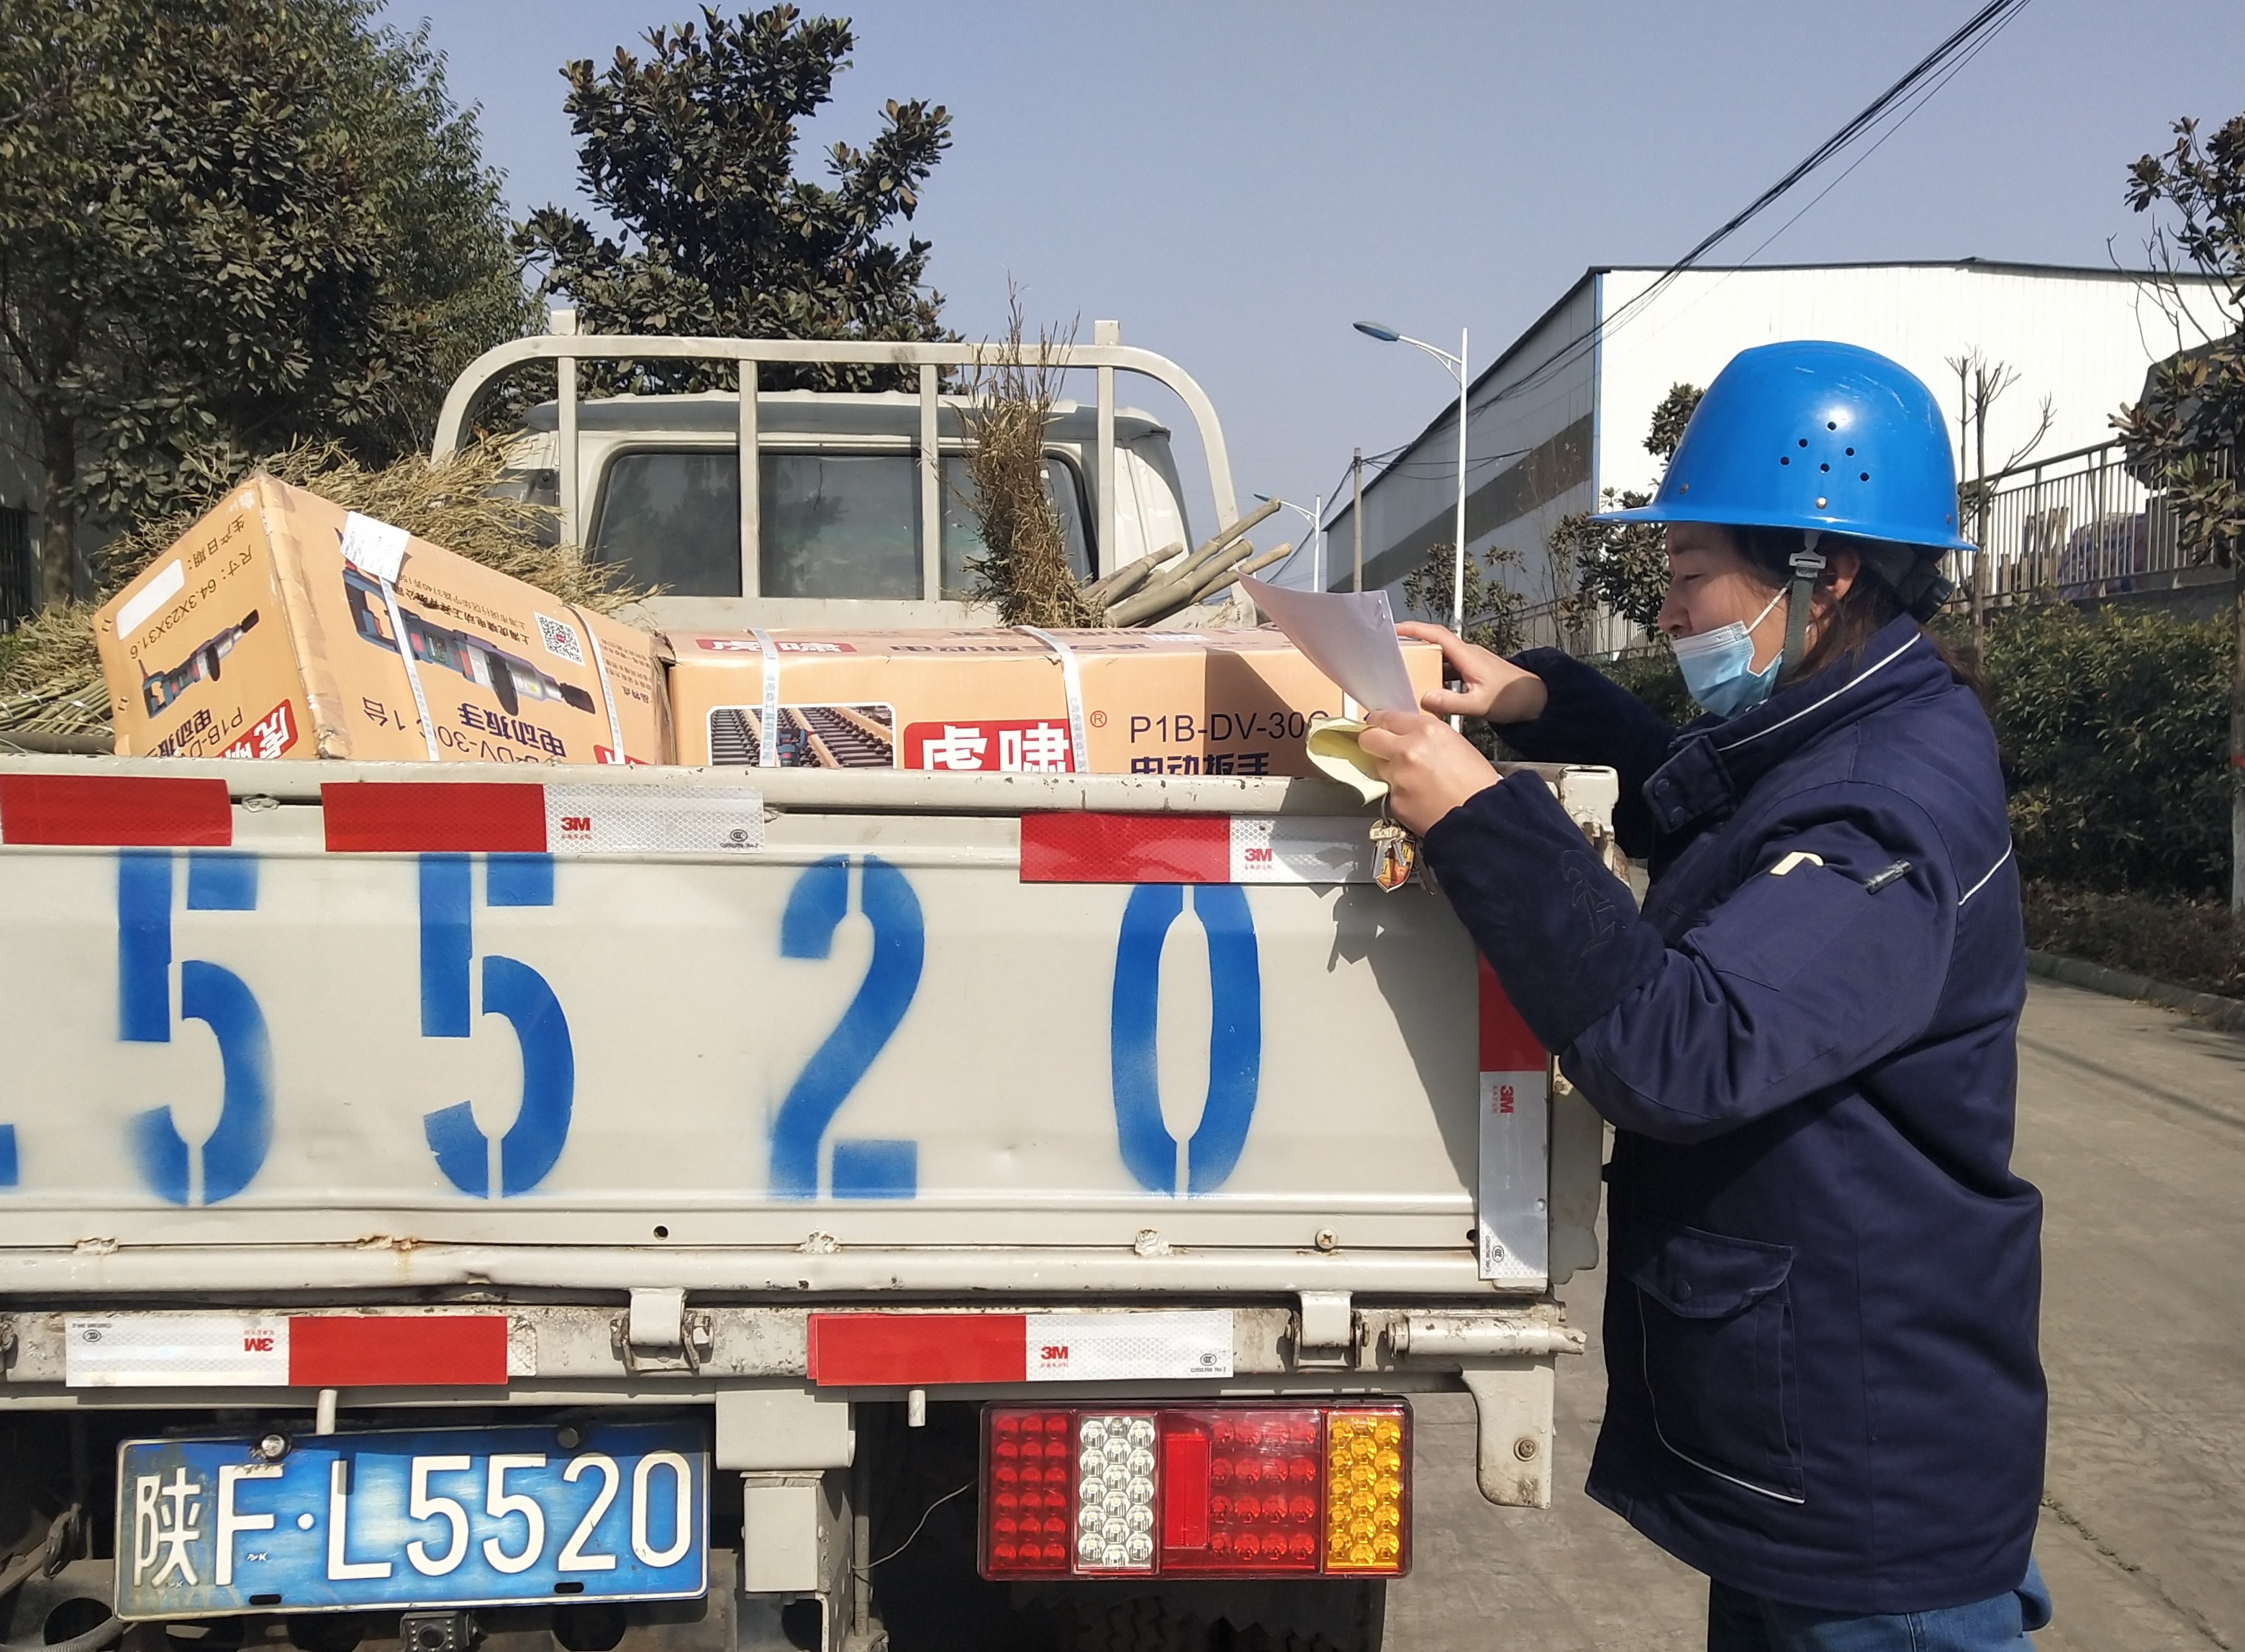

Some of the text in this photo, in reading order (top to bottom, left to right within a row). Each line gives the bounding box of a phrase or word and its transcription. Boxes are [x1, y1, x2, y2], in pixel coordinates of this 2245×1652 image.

[622, 684, 653, 705] 品特点
[362, 696, 407, 731] 1台
[459, 702, 566, 756] 电动扳手
[923, 722, 1069, 771] 虎啸
[1130, 752, 1269, 776] 电动扳手
[561, 817, 590, 831] 3M
[1244, 848, 1273, 861] 3M
[0, 848, 1261, 1205] 5520
[1500, 1085, 1515, 1114] 3M
[244, 1338, 274, 1351] 3M
[1040, 1346, 1069, 1360] 3M
